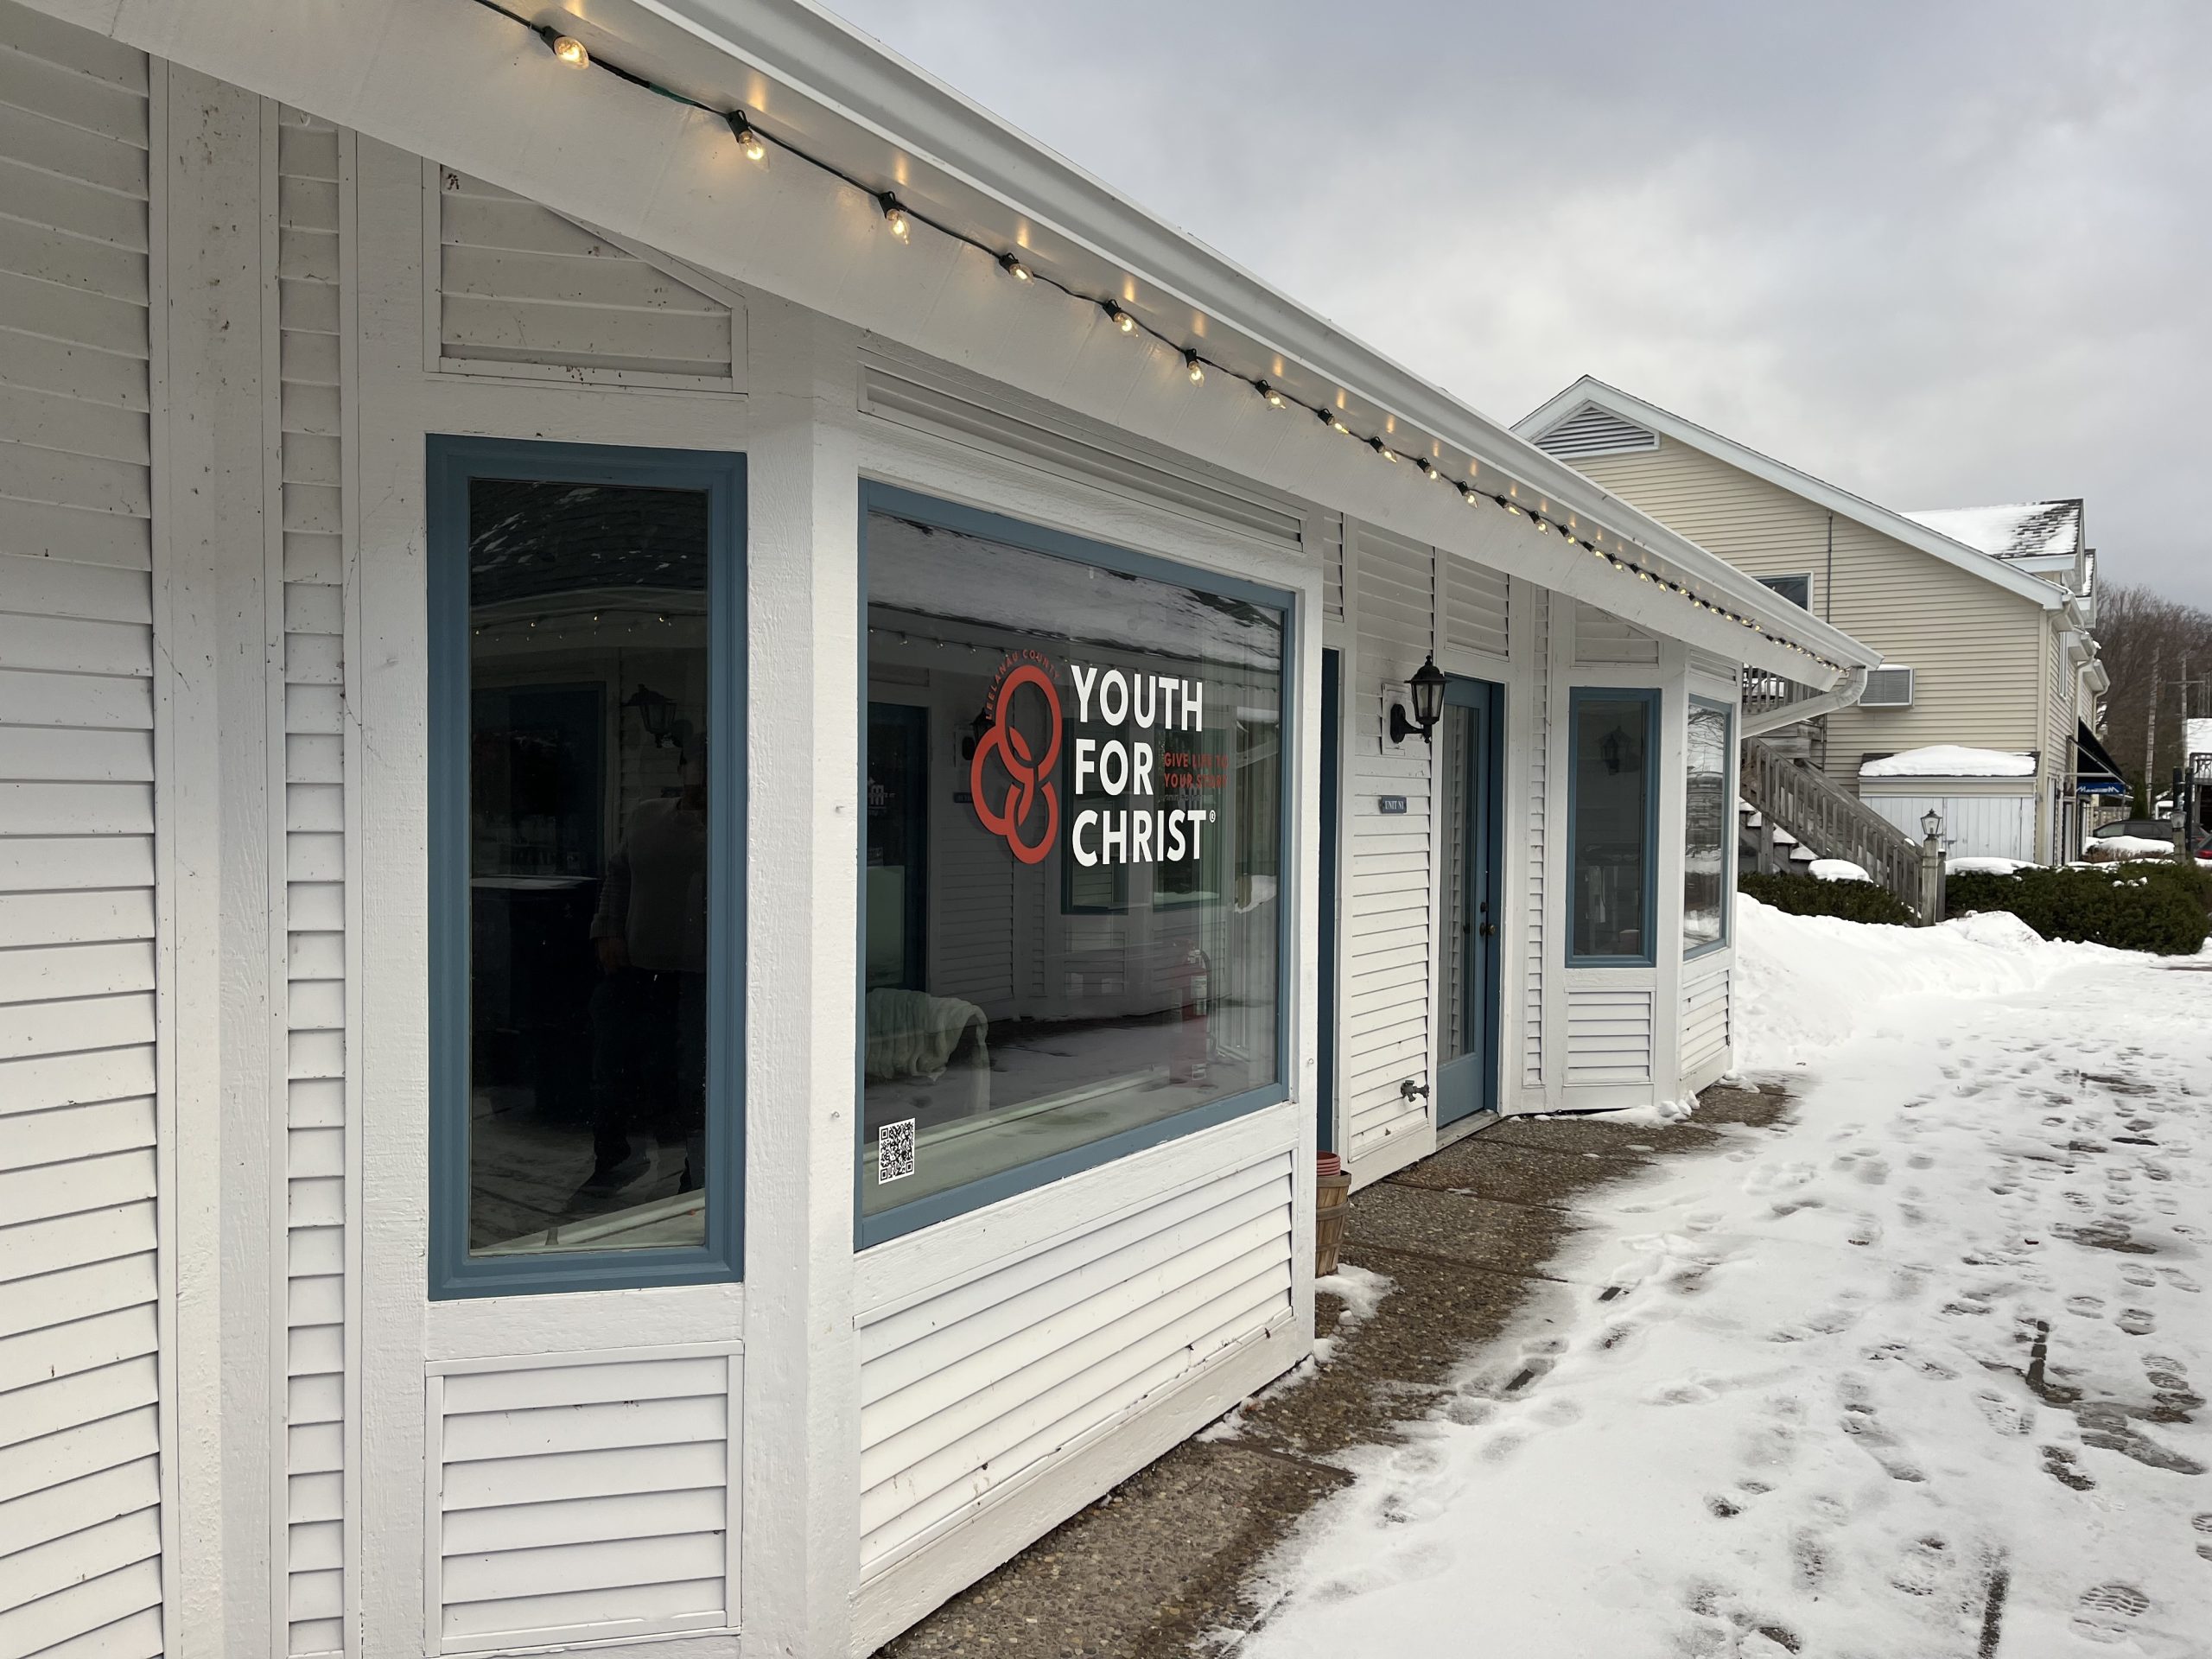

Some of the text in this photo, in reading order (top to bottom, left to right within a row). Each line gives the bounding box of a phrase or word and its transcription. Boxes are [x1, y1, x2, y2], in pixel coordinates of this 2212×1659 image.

[986, 649, 1060, 720] LEELANAU COUNTY
[1071, 665, 1203, 732] YOUTH
[1075, 738, 1154, 796] FOR
[1164, 753, 1189, 767] GIVE
[1164, 773, 1192, 789] YOUR
